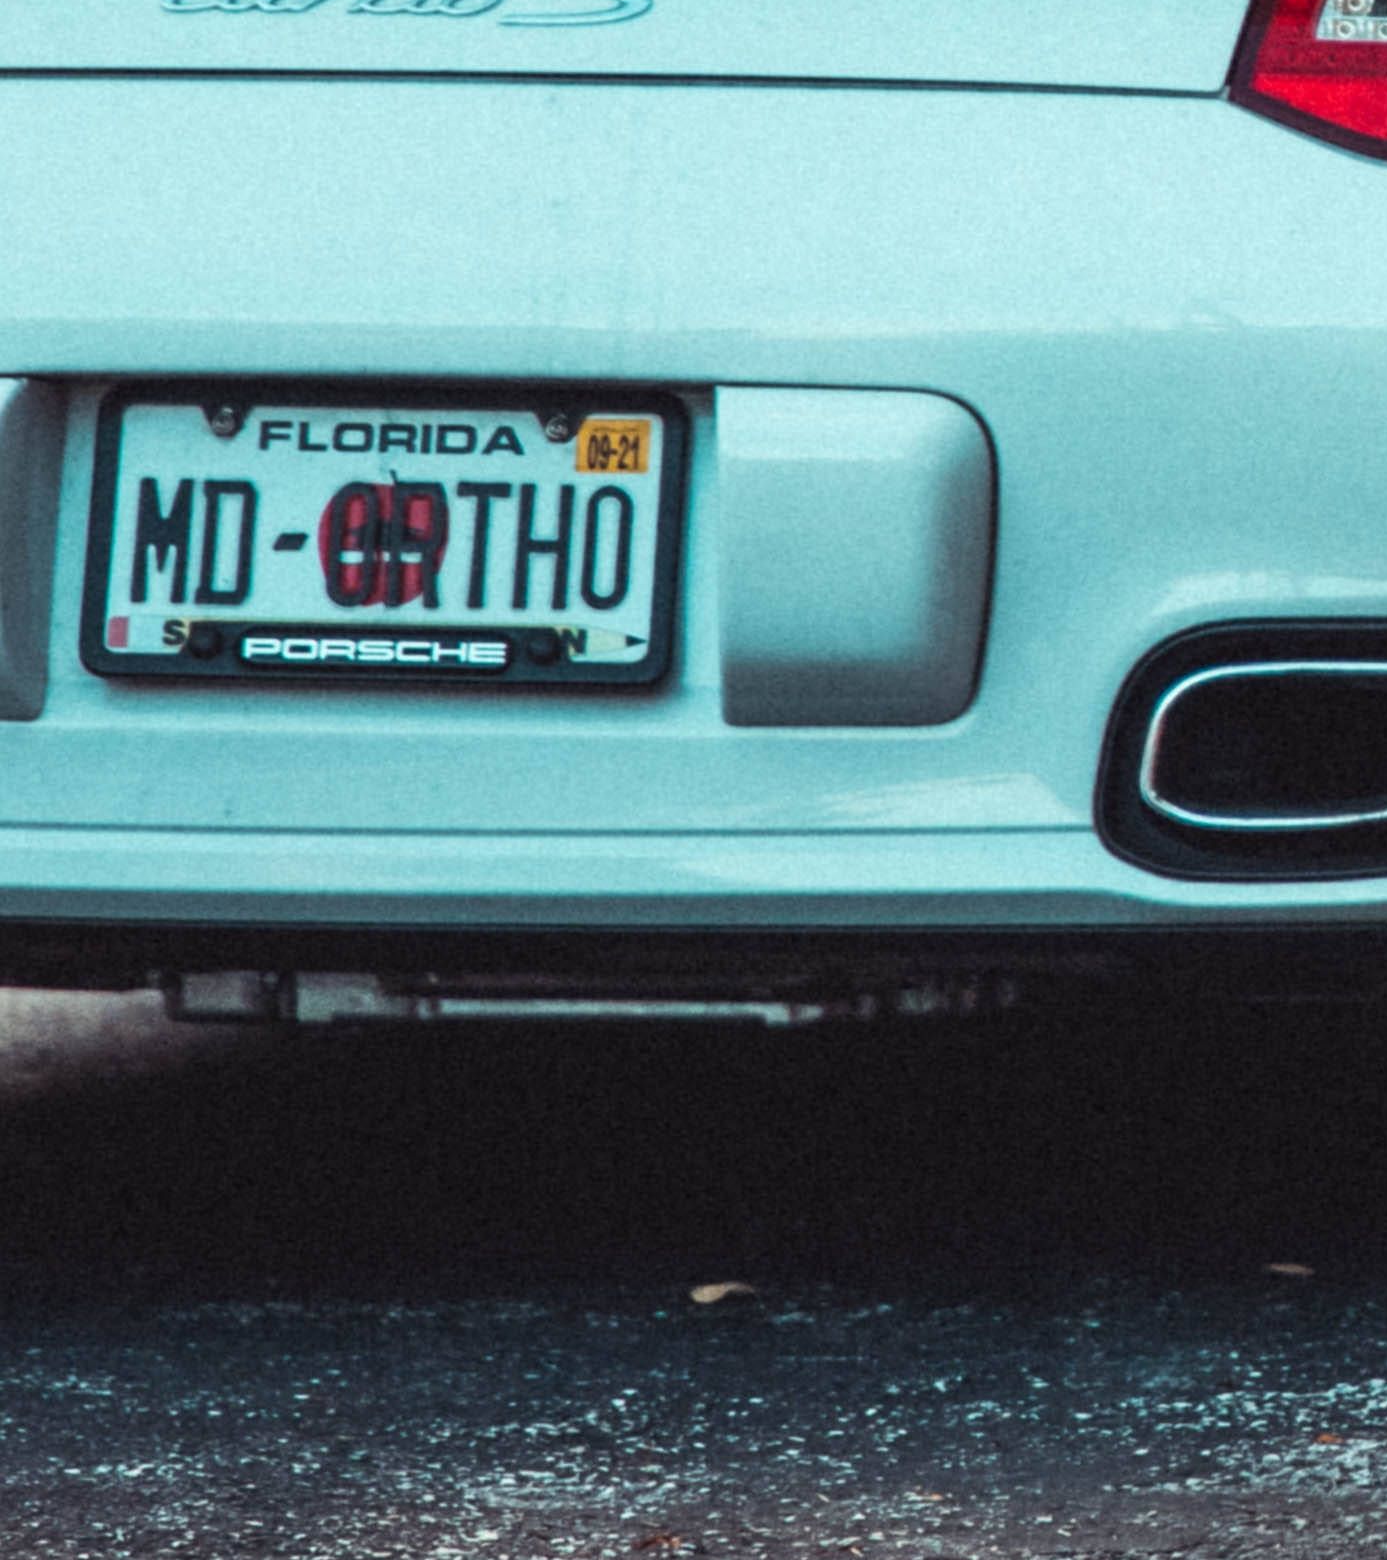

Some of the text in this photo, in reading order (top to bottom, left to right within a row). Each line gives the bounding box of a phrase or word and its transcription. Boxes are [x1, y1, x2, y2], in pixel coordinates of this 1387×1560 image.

[259, 421, 525, 456] FLORIDA
[587, 434, 640, 470] 09-21
[242, 637, 508, 664] PORSCHE
